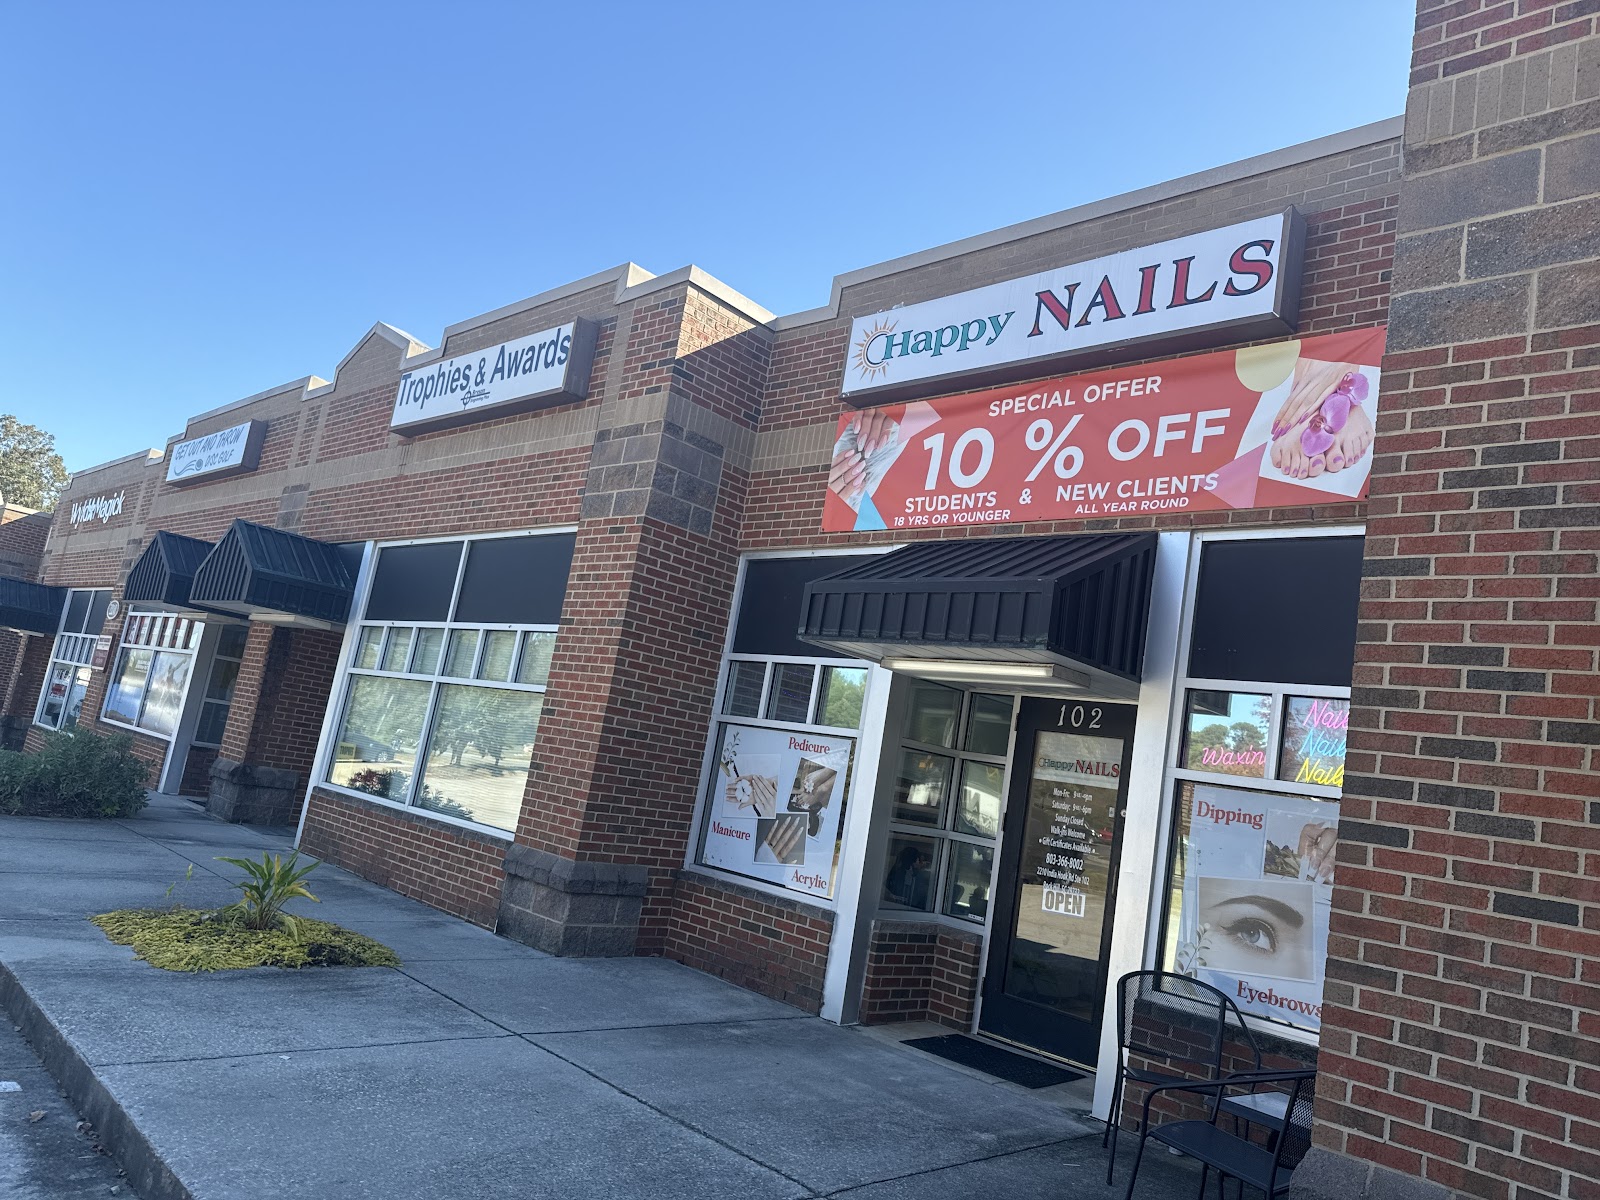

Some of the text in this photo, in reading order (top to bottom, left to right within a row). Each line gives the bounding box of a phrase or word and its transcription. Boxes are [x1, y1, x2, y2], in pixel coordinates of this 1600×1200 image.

[882, 239, 1275, 359] Happy NAILS
[399, 327, 572, 409] Trophies & Awards
[988, 376, 1162, 418] SPECIAL OFFER
[175, 425, 246, 460] GET OUT AND THROW
[923, 407, 1231, 490] 10 % OFF
[204, 449, 235, 468] DISC GOLF
[904, 473, 1219, 513] STUDENTS & NEW CLIENTS
[1074, 497, 1189, 514] ALL YEAR ROUND
[893, 509, 1011, 526] 18 YRS OR YOUNGER
[1057, 704, 1103, 729] 102
[788, 736, 830, 754] Pedicure
[1044, 759, 1120, 777] Happy NAILS
[1055, 813, 1084, 826] Sunday Closed
[1197, 800, 1264, 830] Dipping
[711, 821, 751, 841] Manicure
[1067, 828, 1086, 839] Welcome
[1045, 852, 1084, 870] 803-366-8002
[791, 869, 827, 889] Acrylic
[1047, 868, 1057, 879] India
[1044, 890, 1083, 915] OPEN
[1236, 980, 1322, 1018] Eyebrows
